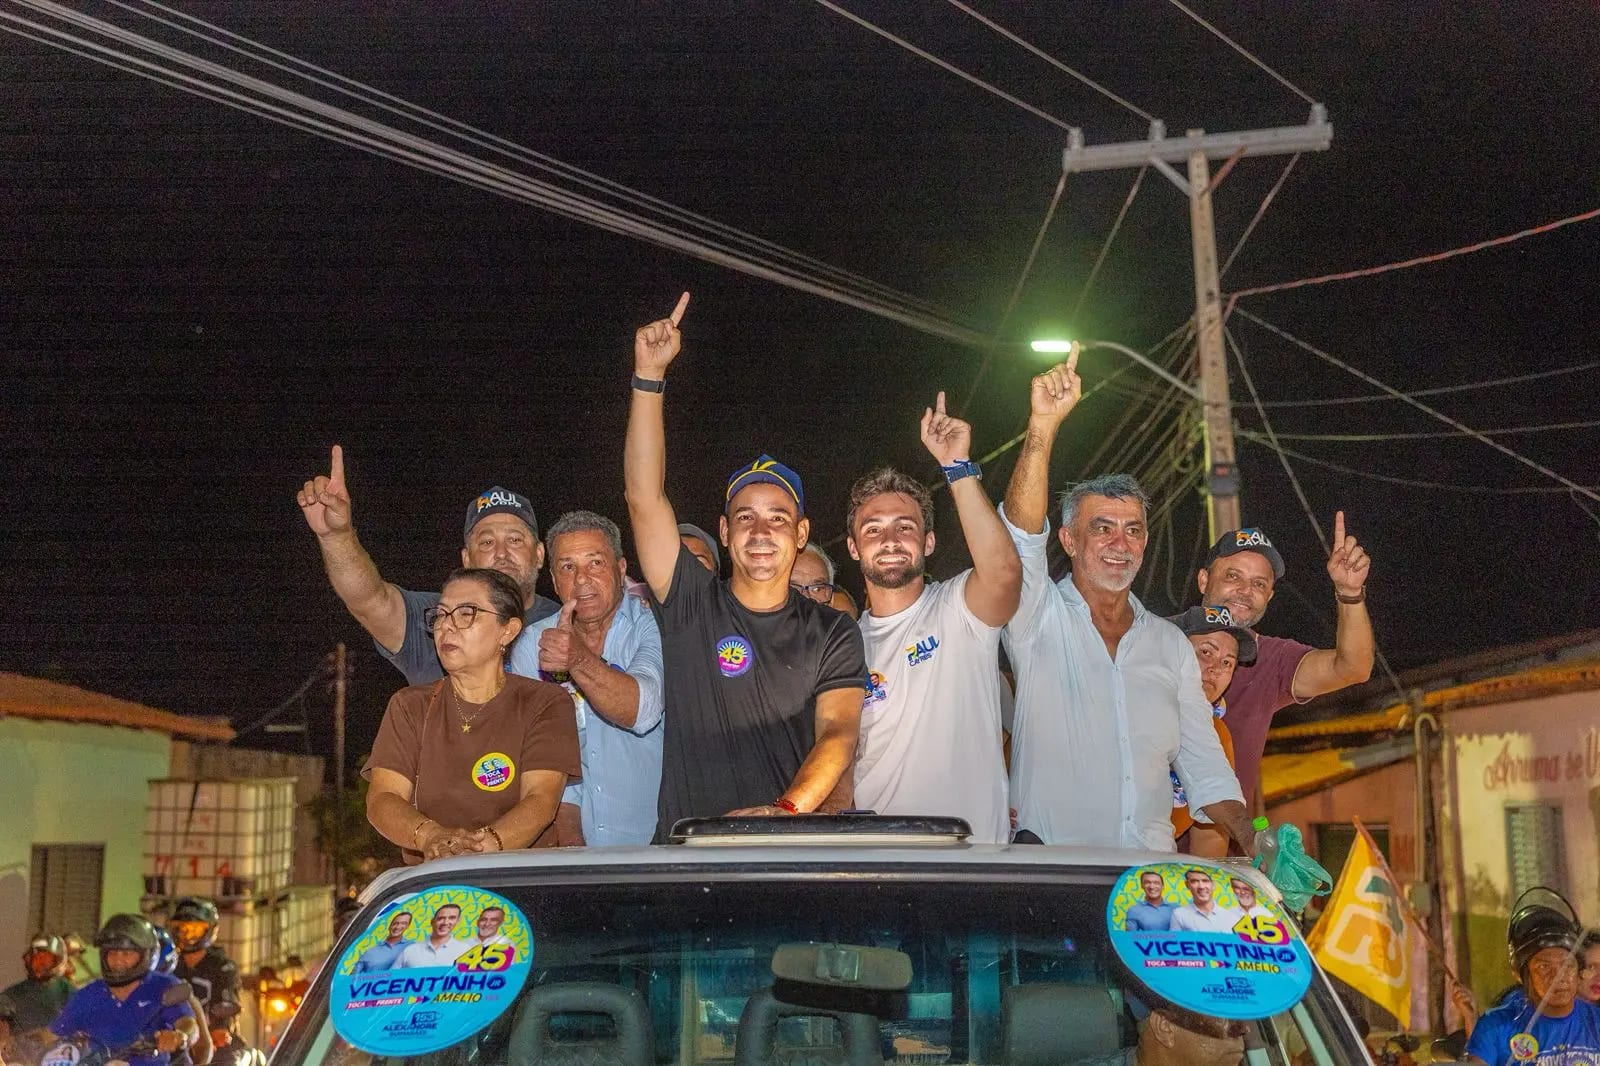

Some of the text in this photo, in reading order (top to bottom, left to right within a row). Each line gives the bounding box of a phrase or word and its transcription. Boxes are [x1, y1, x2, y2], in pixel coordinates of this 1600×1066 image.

[719, 647, 744, 664] 45
[1233, 914, 1285, 944] 45
[455, 943, 509, 971] 45
[1134, 940, 1297, 963] VICENTINHO
[1177, 960, 1205, 968] FRENTE
[350, 974, 507, 999] VICENTINHO
[347, 1001, 366, 1009] TOCA
[376, 998, 404, 1007] FRENTE
